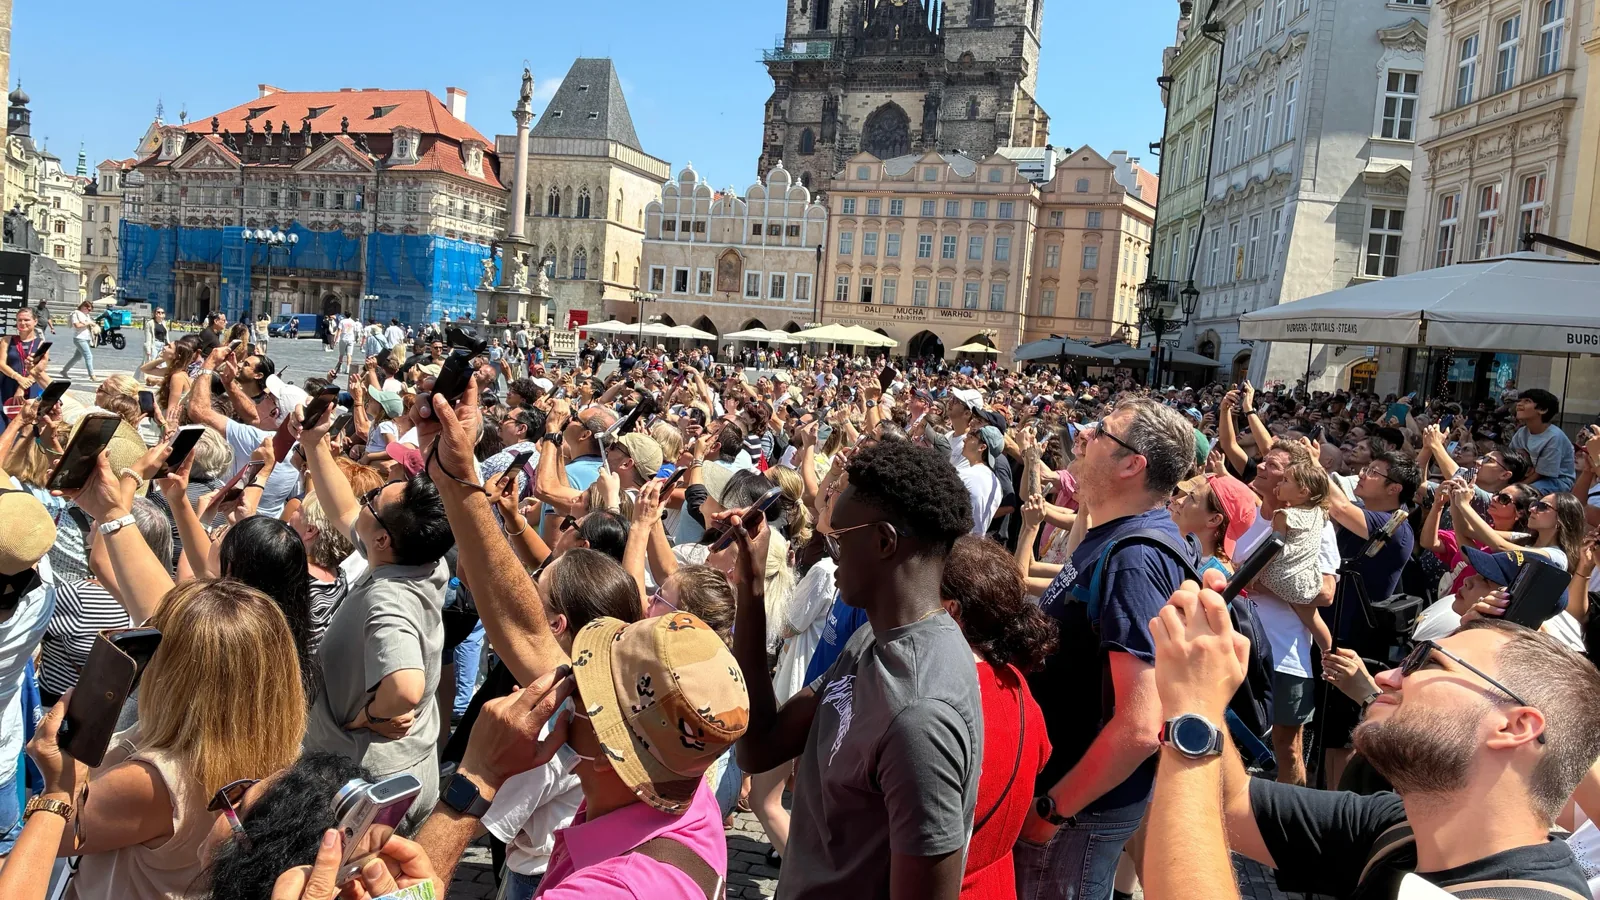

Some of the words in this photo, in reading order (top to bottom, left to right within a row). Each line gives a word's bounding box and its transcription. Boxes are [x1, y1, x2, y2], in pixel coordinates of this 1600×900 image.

[1268, 214, 1291, 300] HOTEL
[864, 305, 881, 314] DALI
[896, 307, 924, 316] MUCHA
[940, 309, 973, 319] WARHOL
[1286, 323, 1308, 333] BURGERS
[1338, 323, 1358, 334] STEAKS
[1566, 332, 1600, 346] BURG
